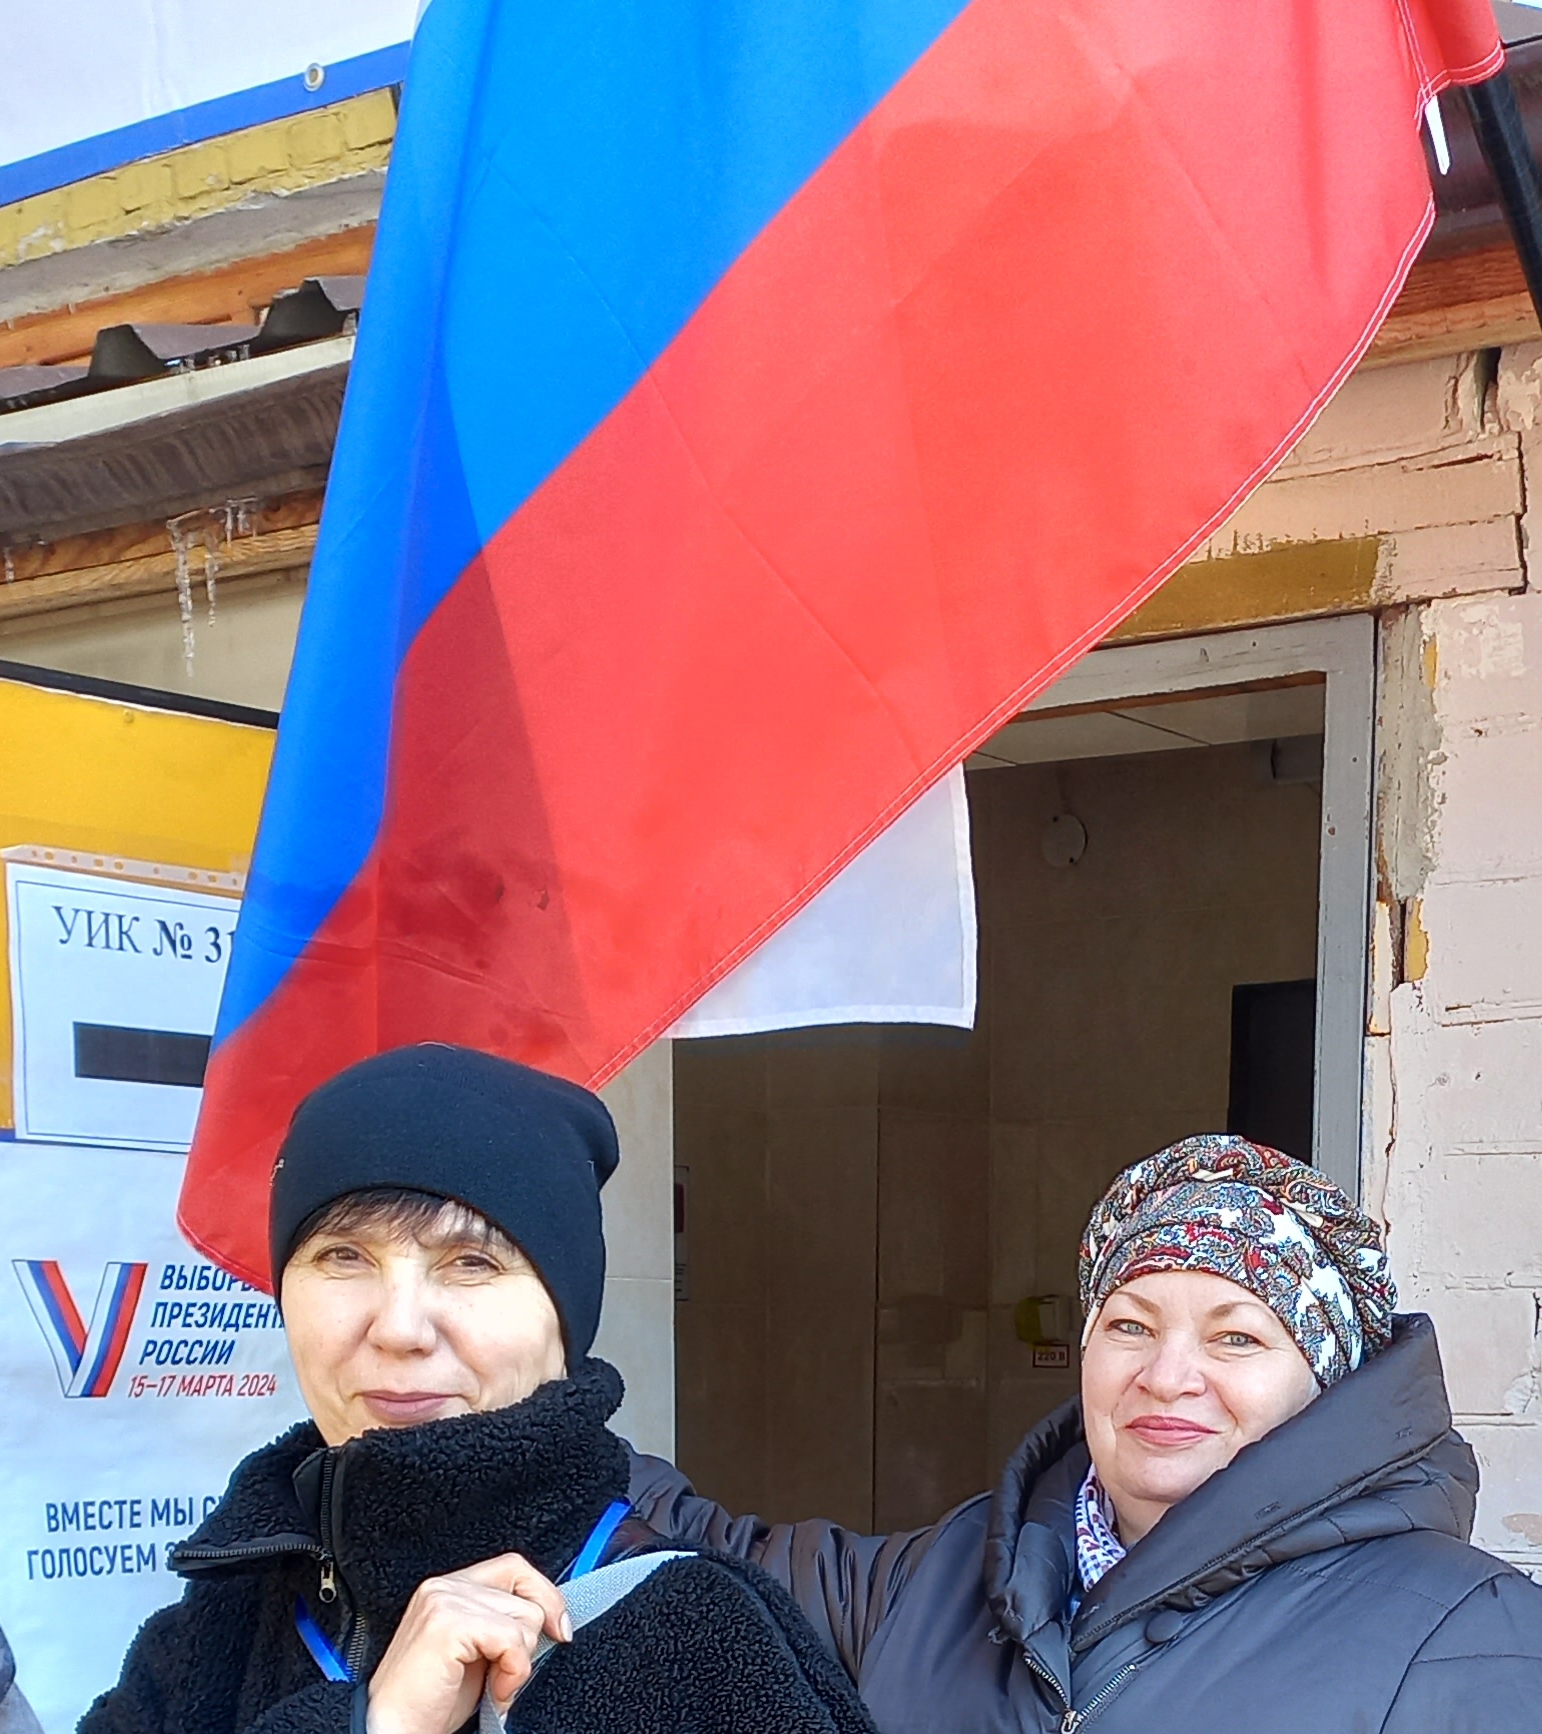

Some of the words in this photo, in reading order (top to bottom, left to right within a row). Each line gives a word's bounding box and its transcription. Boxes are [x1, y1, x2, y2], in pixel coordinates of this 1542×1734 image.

[51, 905, 143, 953] УИК
[152, 919, 194, 959] №
[139, 1340, 236, 1366] РОССИИ
[178, 1374, 233, 1398] МАРТА
[236, 1373, 278, 1397] 2024
[45, 1499, 143, 1533] ВМЕСТЕ
[151, 1497, 194, 1528] МЫ
[26, 1541, 157, 1580] ГОЛОСУЕМ
